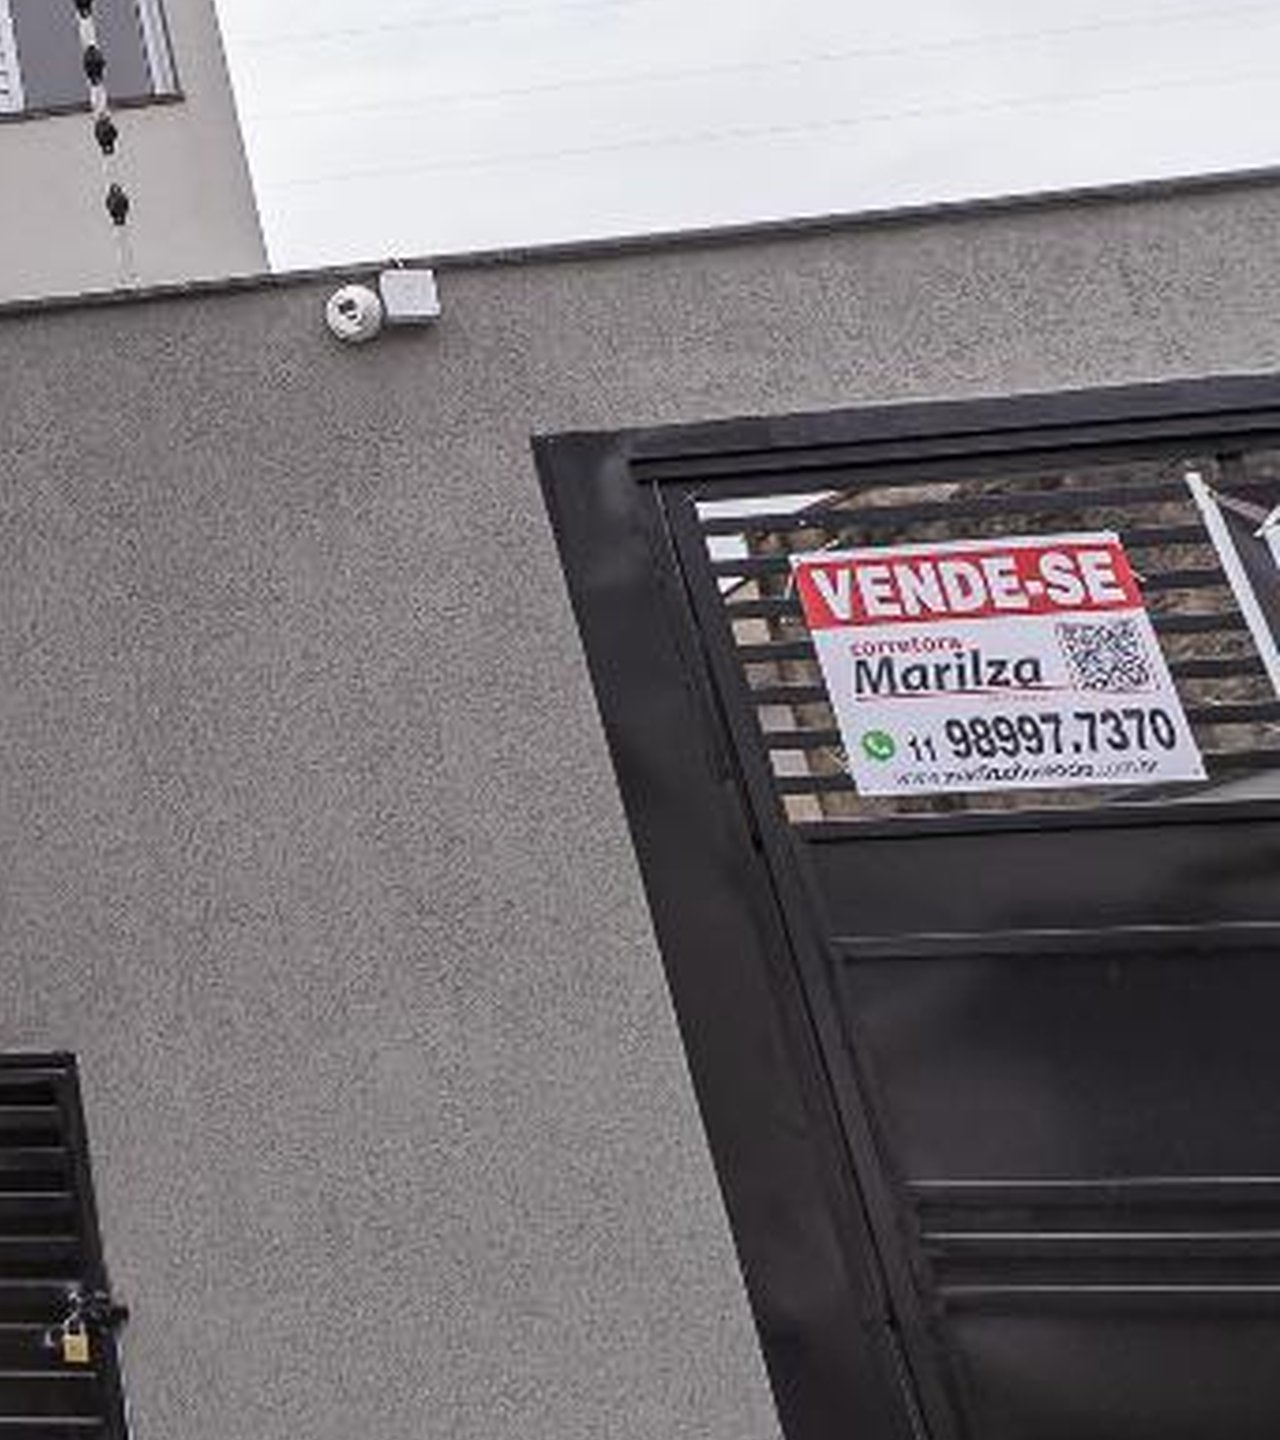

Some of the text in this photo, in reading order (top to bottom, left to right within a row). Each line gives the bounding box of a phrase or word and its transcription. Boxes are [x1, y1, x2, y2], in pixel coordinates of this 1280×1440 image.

[810, 550, 1128, 621] VENDE-SE
[854, 649, 1042, 695] Marilza
[908, 707, 1178, 763] 11 98997.7370
